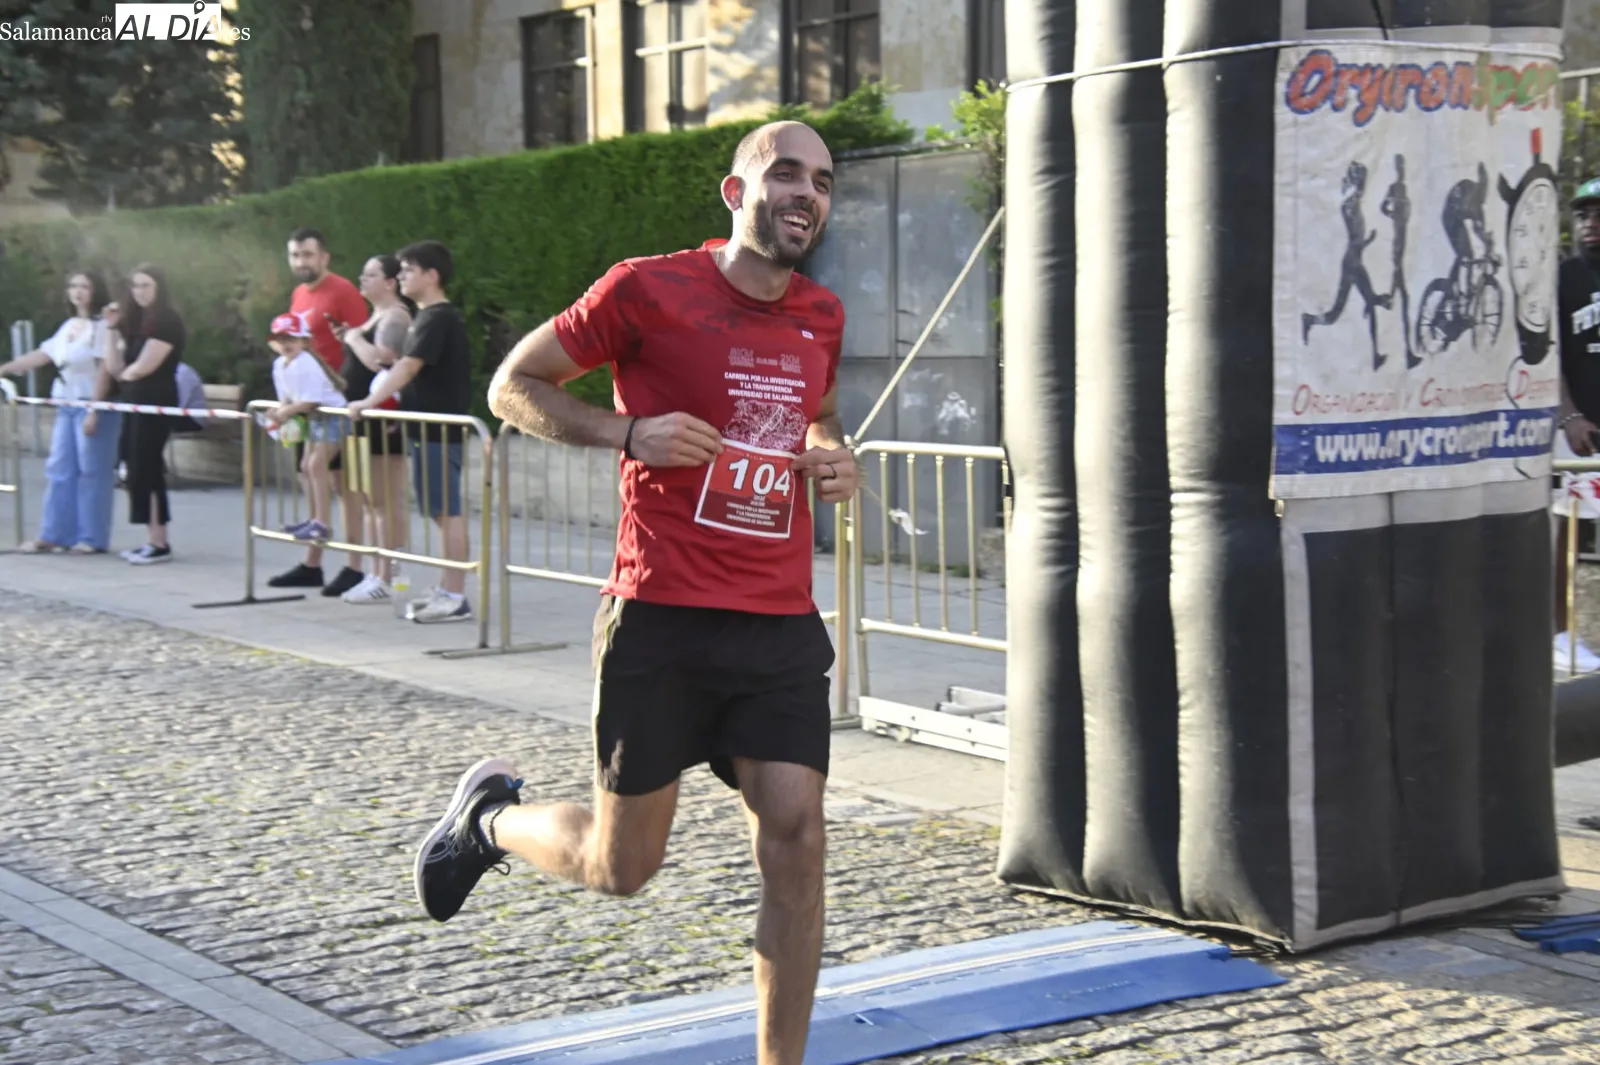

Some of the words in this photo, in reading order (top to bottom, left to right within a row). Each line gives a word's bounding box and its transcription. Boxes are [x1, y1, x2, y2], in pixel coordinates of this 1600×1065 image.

[724, 371, 750, 381] CARRERA
[750, 374, 761, 382] POR
[761, 375, 770, 383] LA
[744, 382, 752, 390] LA
[752, 383, 793, 394] TRANSFERENCIA
[728, 388, 763, 399] UNIVERSIDAD
[763, 391, 772, 400] DE
[772, 392, 802, 403] SALAMANCA
[728, 457, 791, 497] 104
